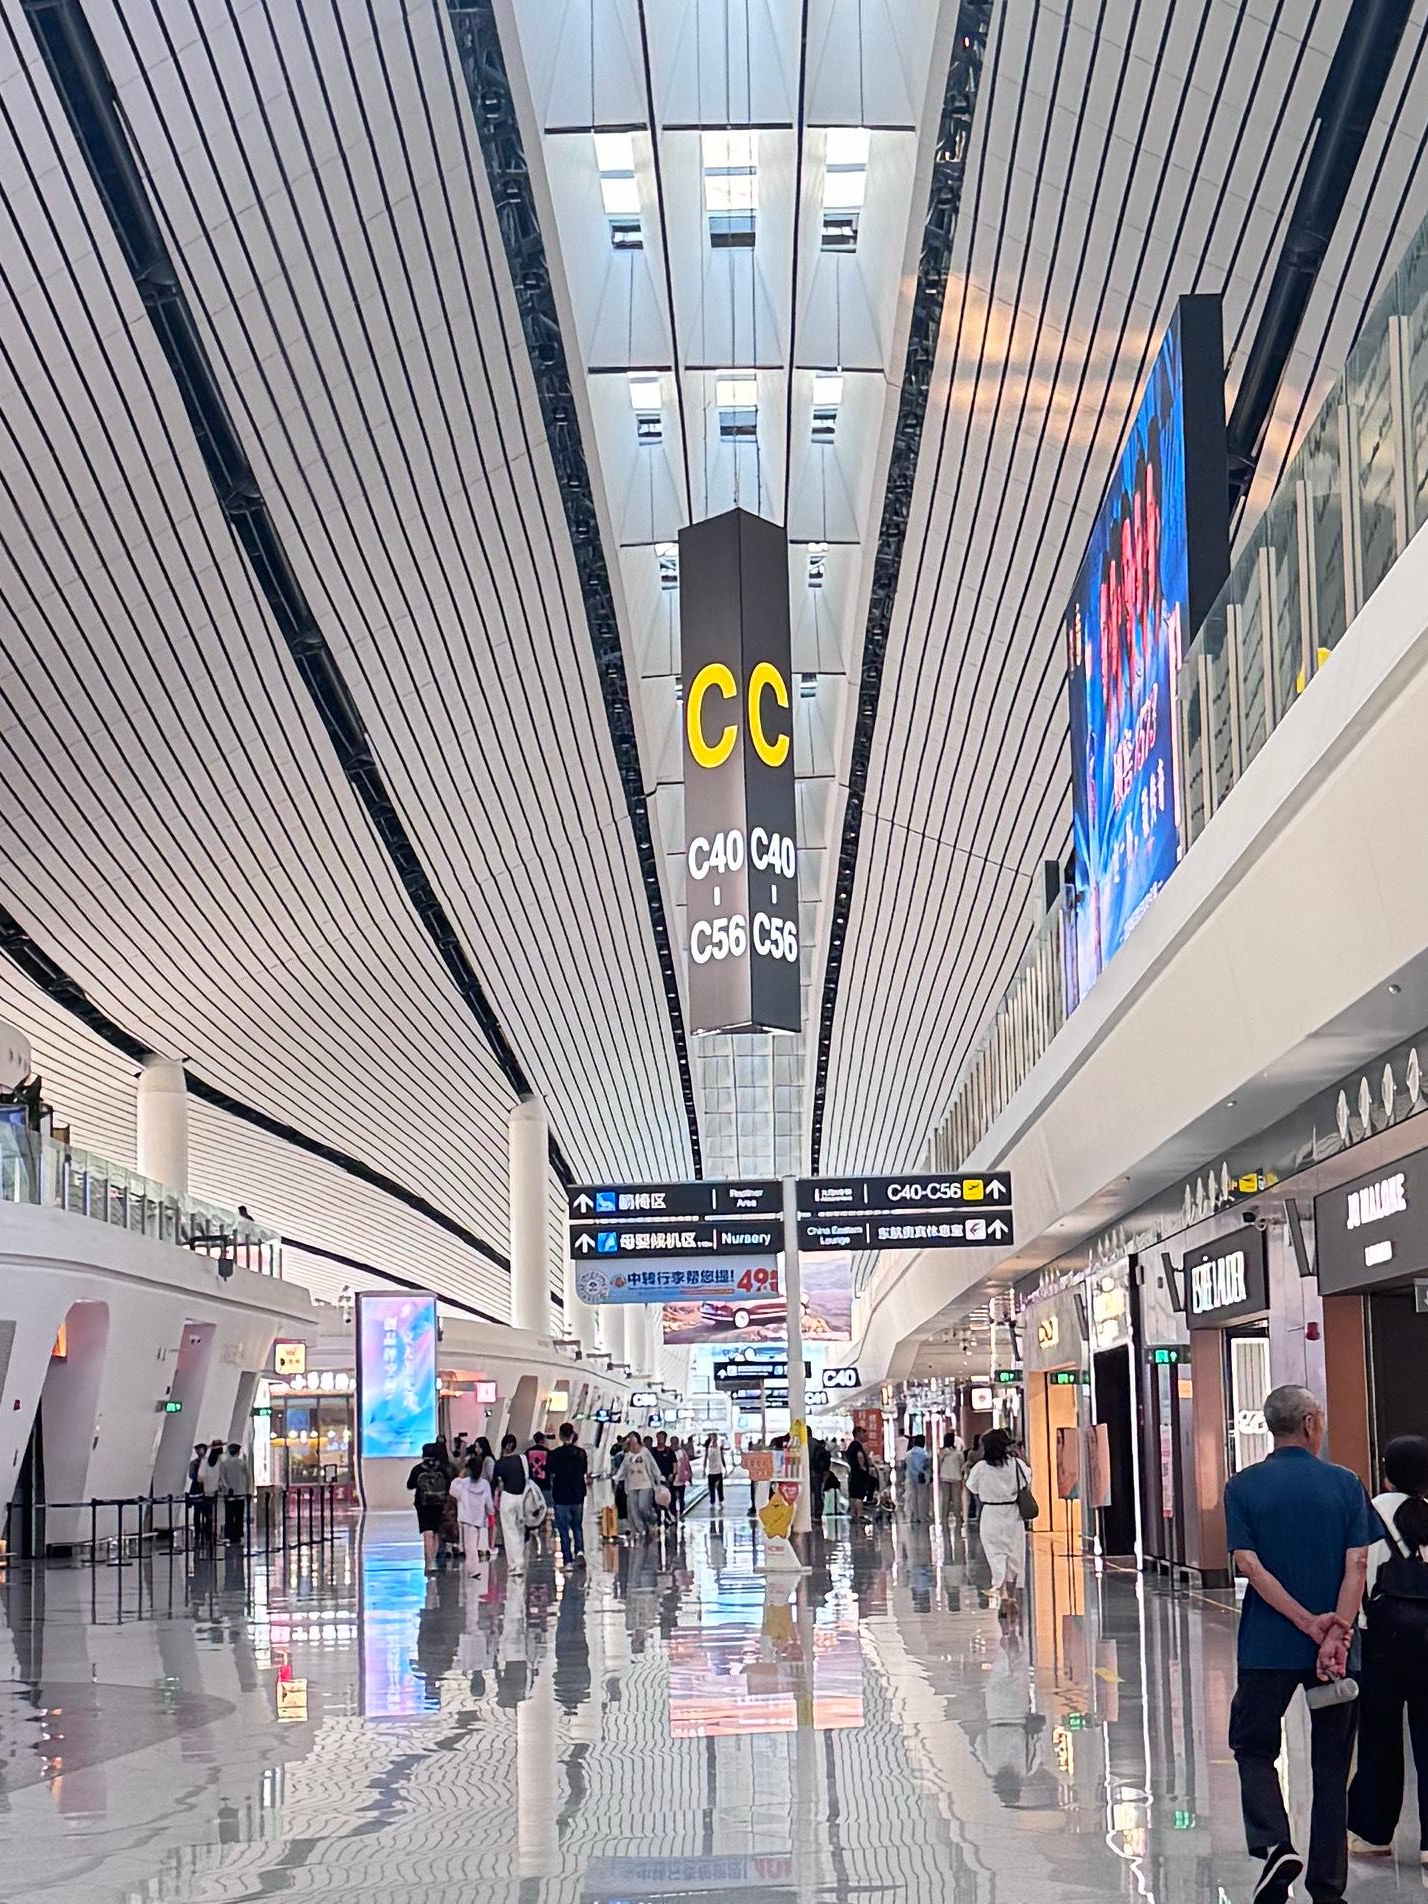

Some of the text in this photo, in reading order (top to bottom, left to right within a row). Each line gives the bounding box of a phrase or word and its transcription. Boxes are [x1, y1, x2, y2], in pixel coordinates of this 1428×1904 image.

[686, 662, 738, 769] C
[748, 661, 790, 768] C
[688, 828, 744, 880] C40
[750, 826, 796, 879] C40
[690, 913, 747, 965] C56
[752, 911, 798, 963] C56
[887, 1182, 962, 1201] C40-C56
[822, 1369, 857, 1388] C40
